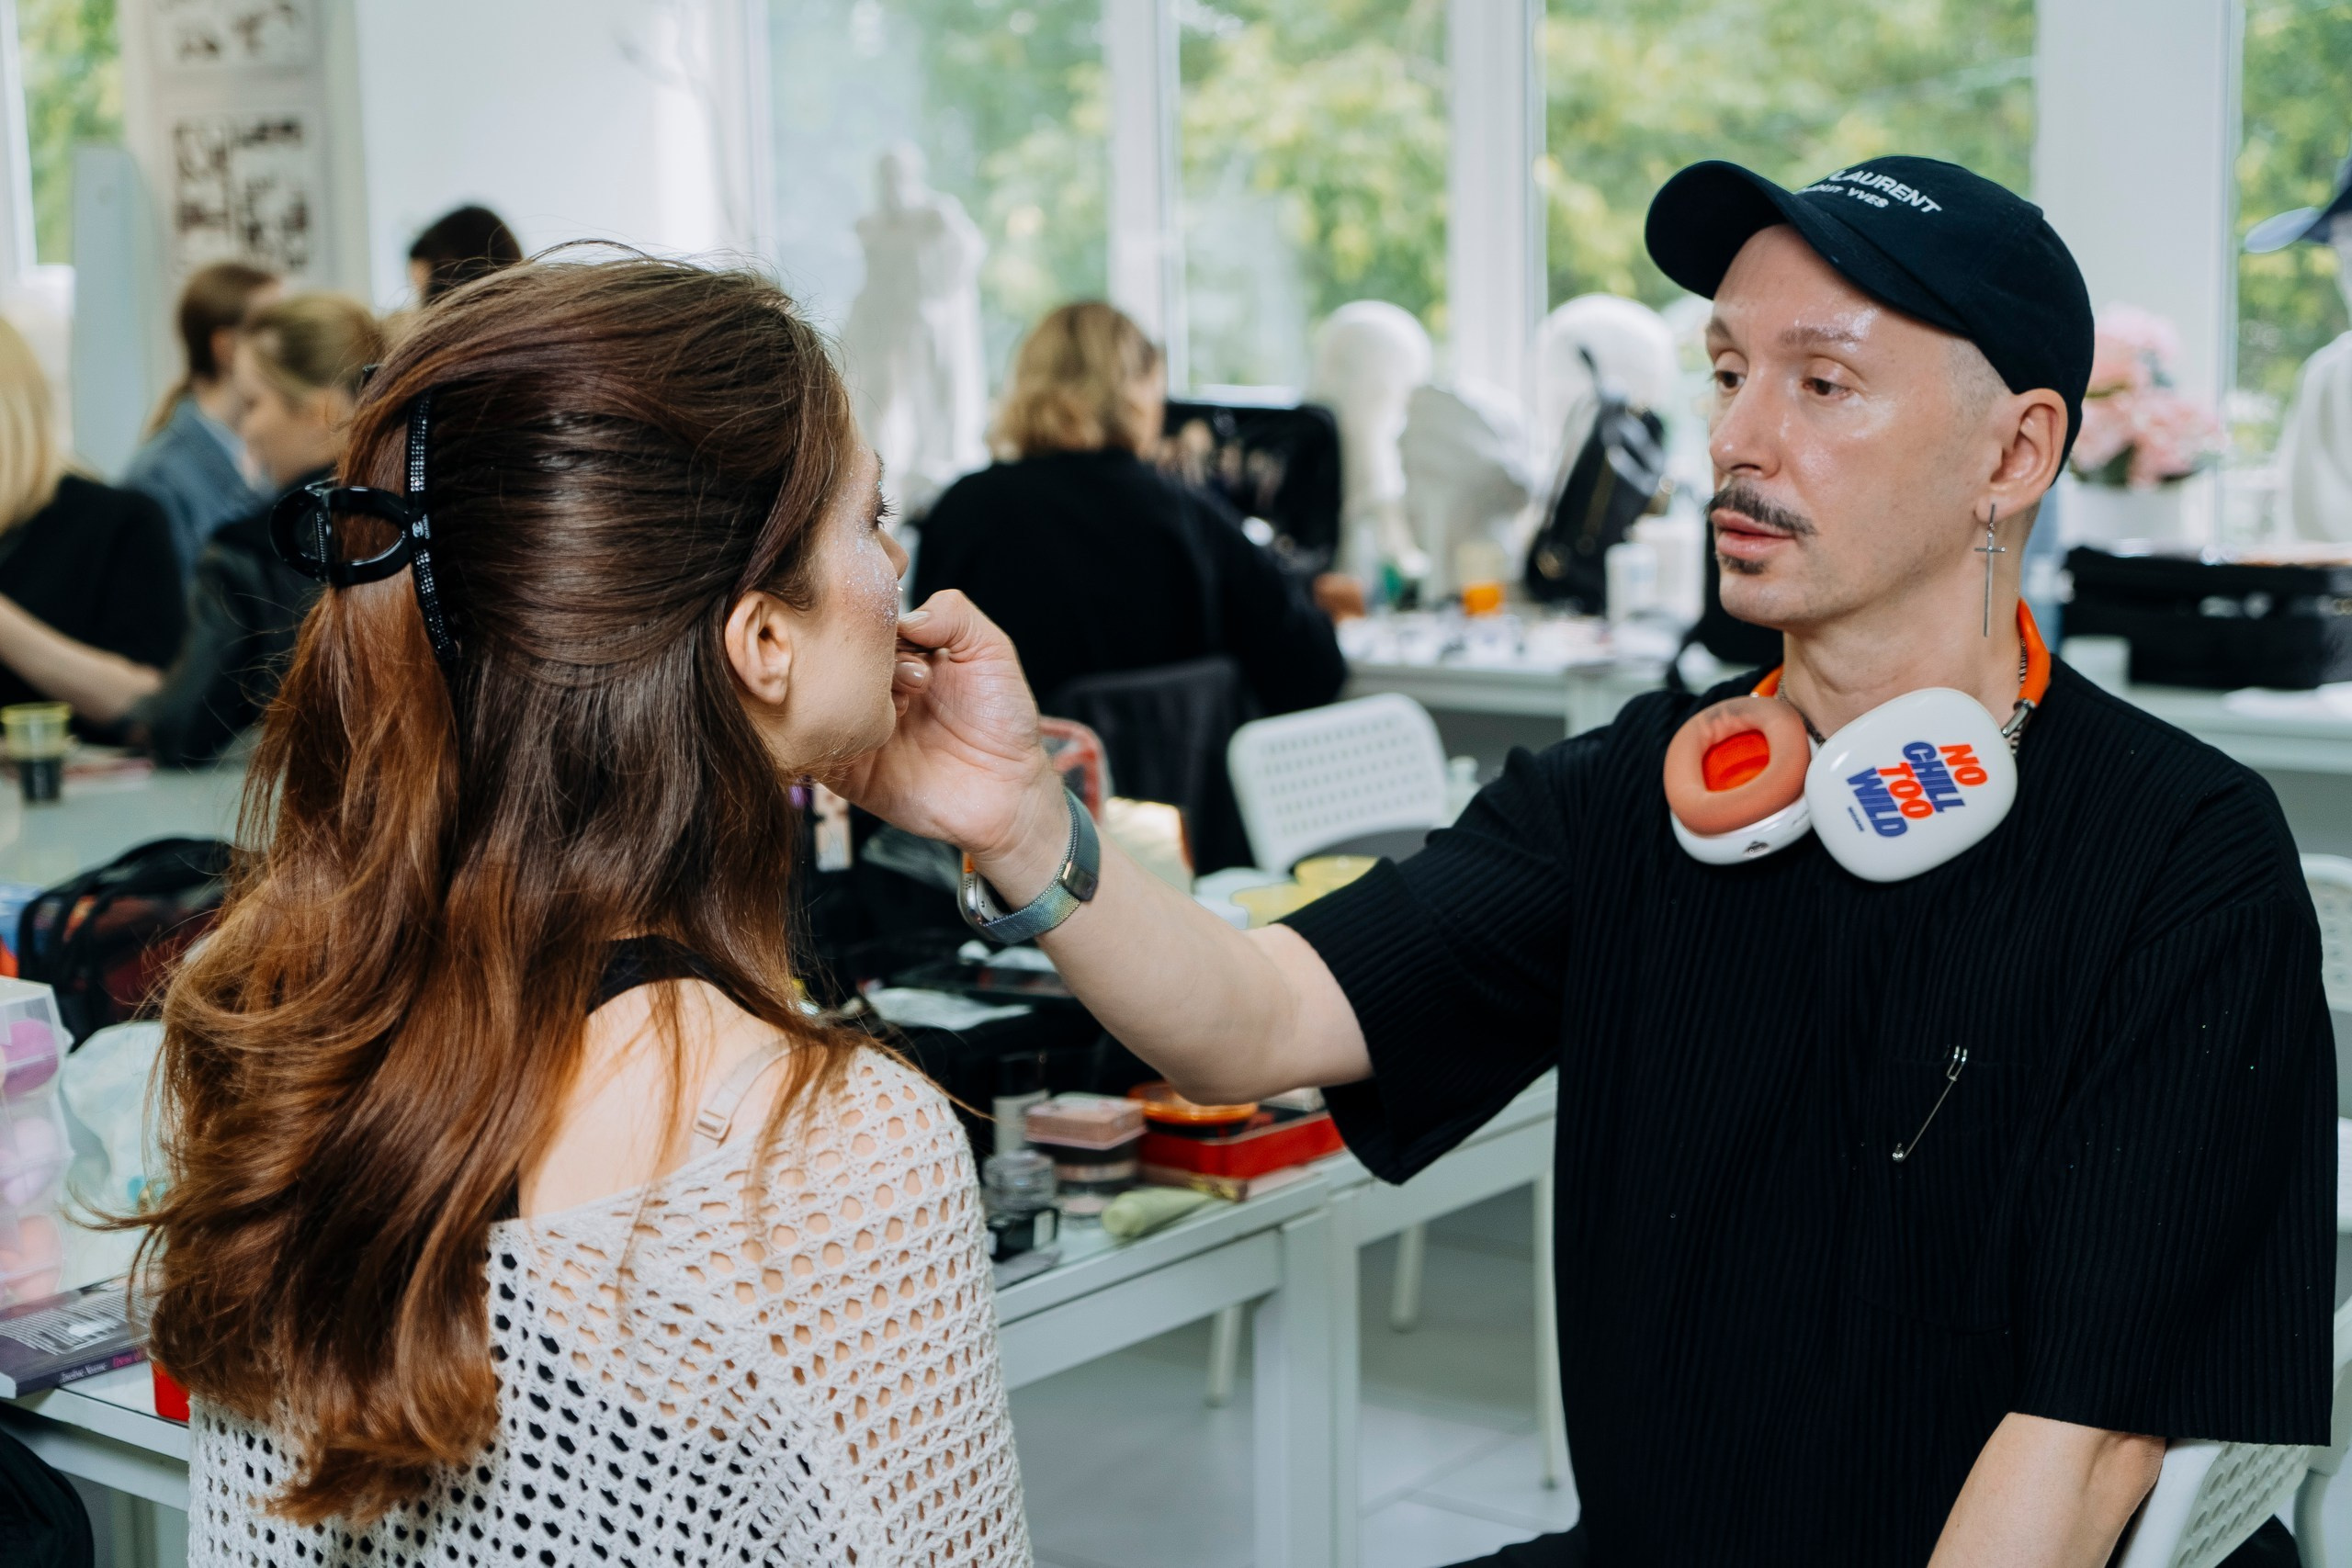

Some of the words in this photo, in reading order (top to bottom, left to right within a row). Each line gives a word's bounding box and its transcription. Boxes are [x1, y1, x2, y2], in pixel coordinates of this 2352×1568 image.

[1828, 170, 1942, 213] LAURENT
[1847, 187, 1889, 208] YVES
[1877, 761, 1934, 818] TOO
[1903, 740, 1965, 813] CHILL
[1939, 743, 1988, 786] NO
[1847, 765, 1907, 837] WILD
